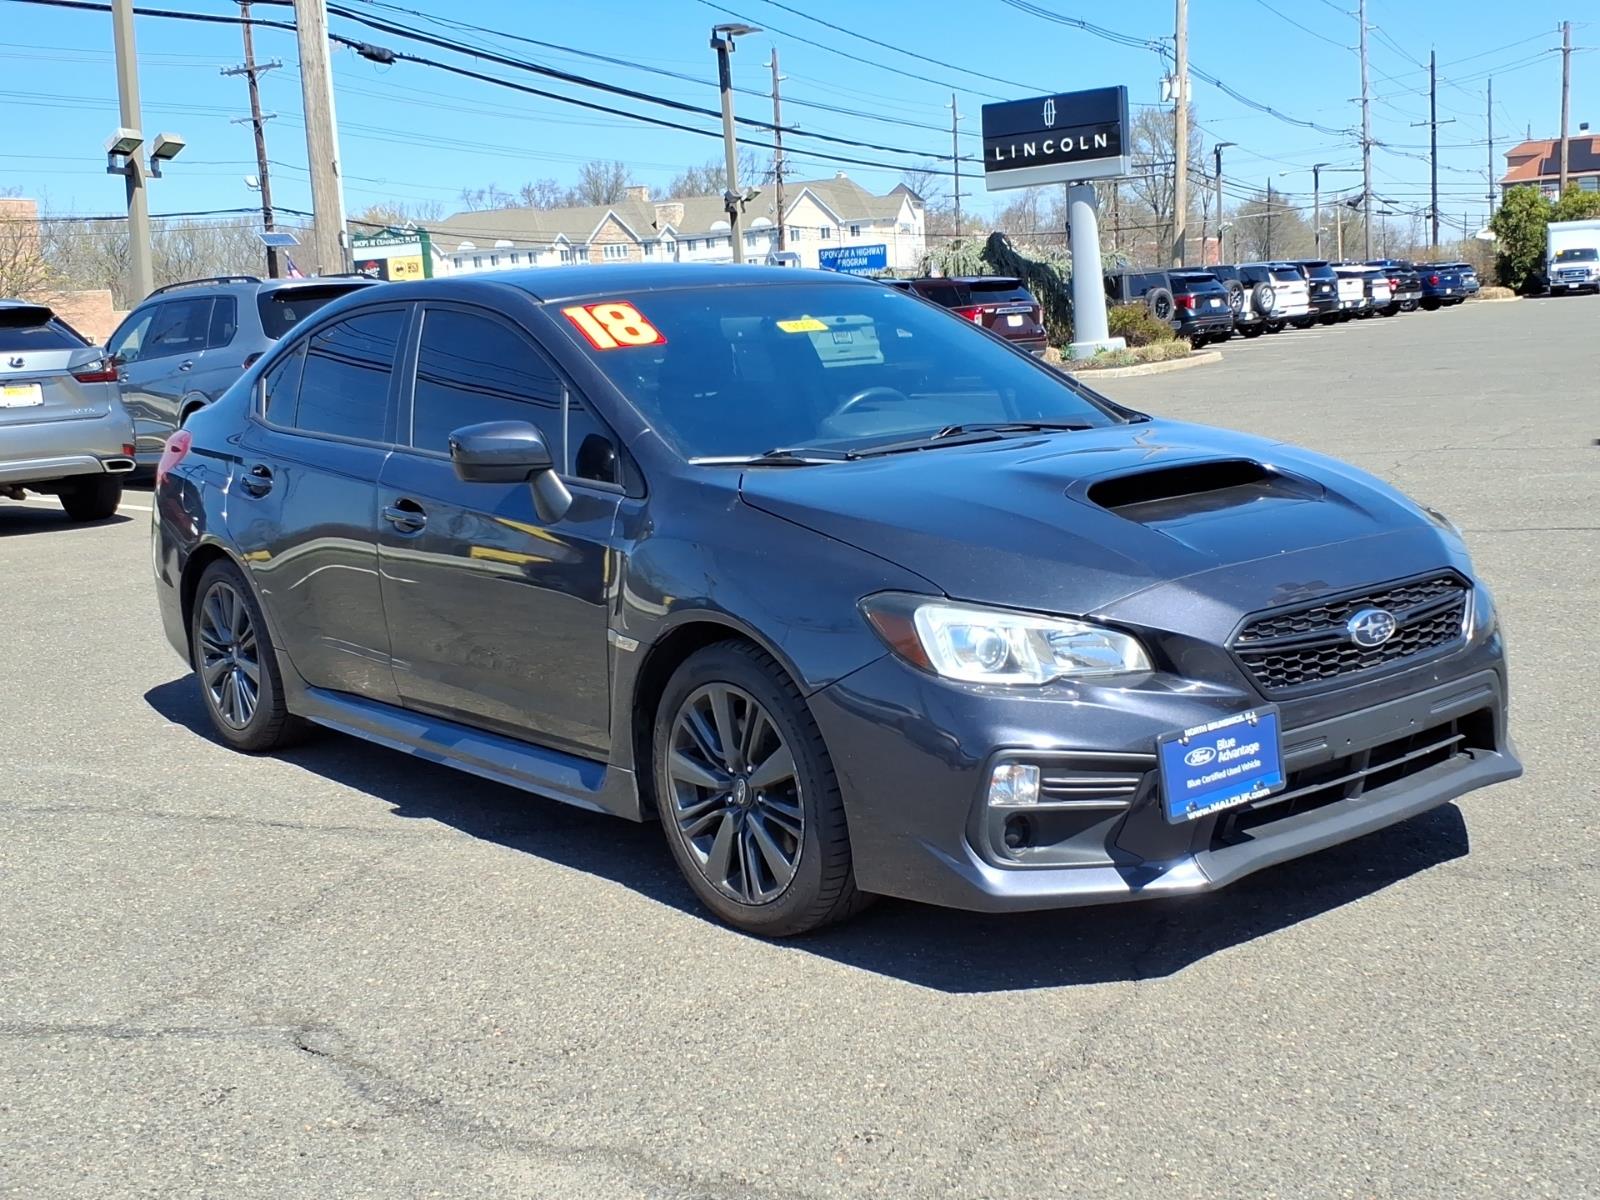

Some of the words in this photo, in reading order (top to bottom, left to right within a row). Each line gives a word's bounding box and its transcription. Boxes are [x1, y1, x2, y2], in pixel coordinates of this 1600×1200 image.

[995, 133, 1107, 161] LINCOLN
[820, 250, 850, 260] SPONSOR
[850, 248, 856, 257] A
[857, 246, 884, 256] HIGHWAY
[837, 257, 868, 267] PROGRAM
[561, 303, 661, 349] 18
[1184, 724, 1208, 738] NORTH
[1216, 737, 1236, 751] Blue
[1190, 749, 1211, 764] Ford
[1218, 742, 1260, 763] Advantage
[1186, 778, 1201, 789] Blue
[1202, 769, 1227, 784] Certified
[1227, 765, 1241, 776] Used
[1241, 759, 1261, 772] Vehicle
